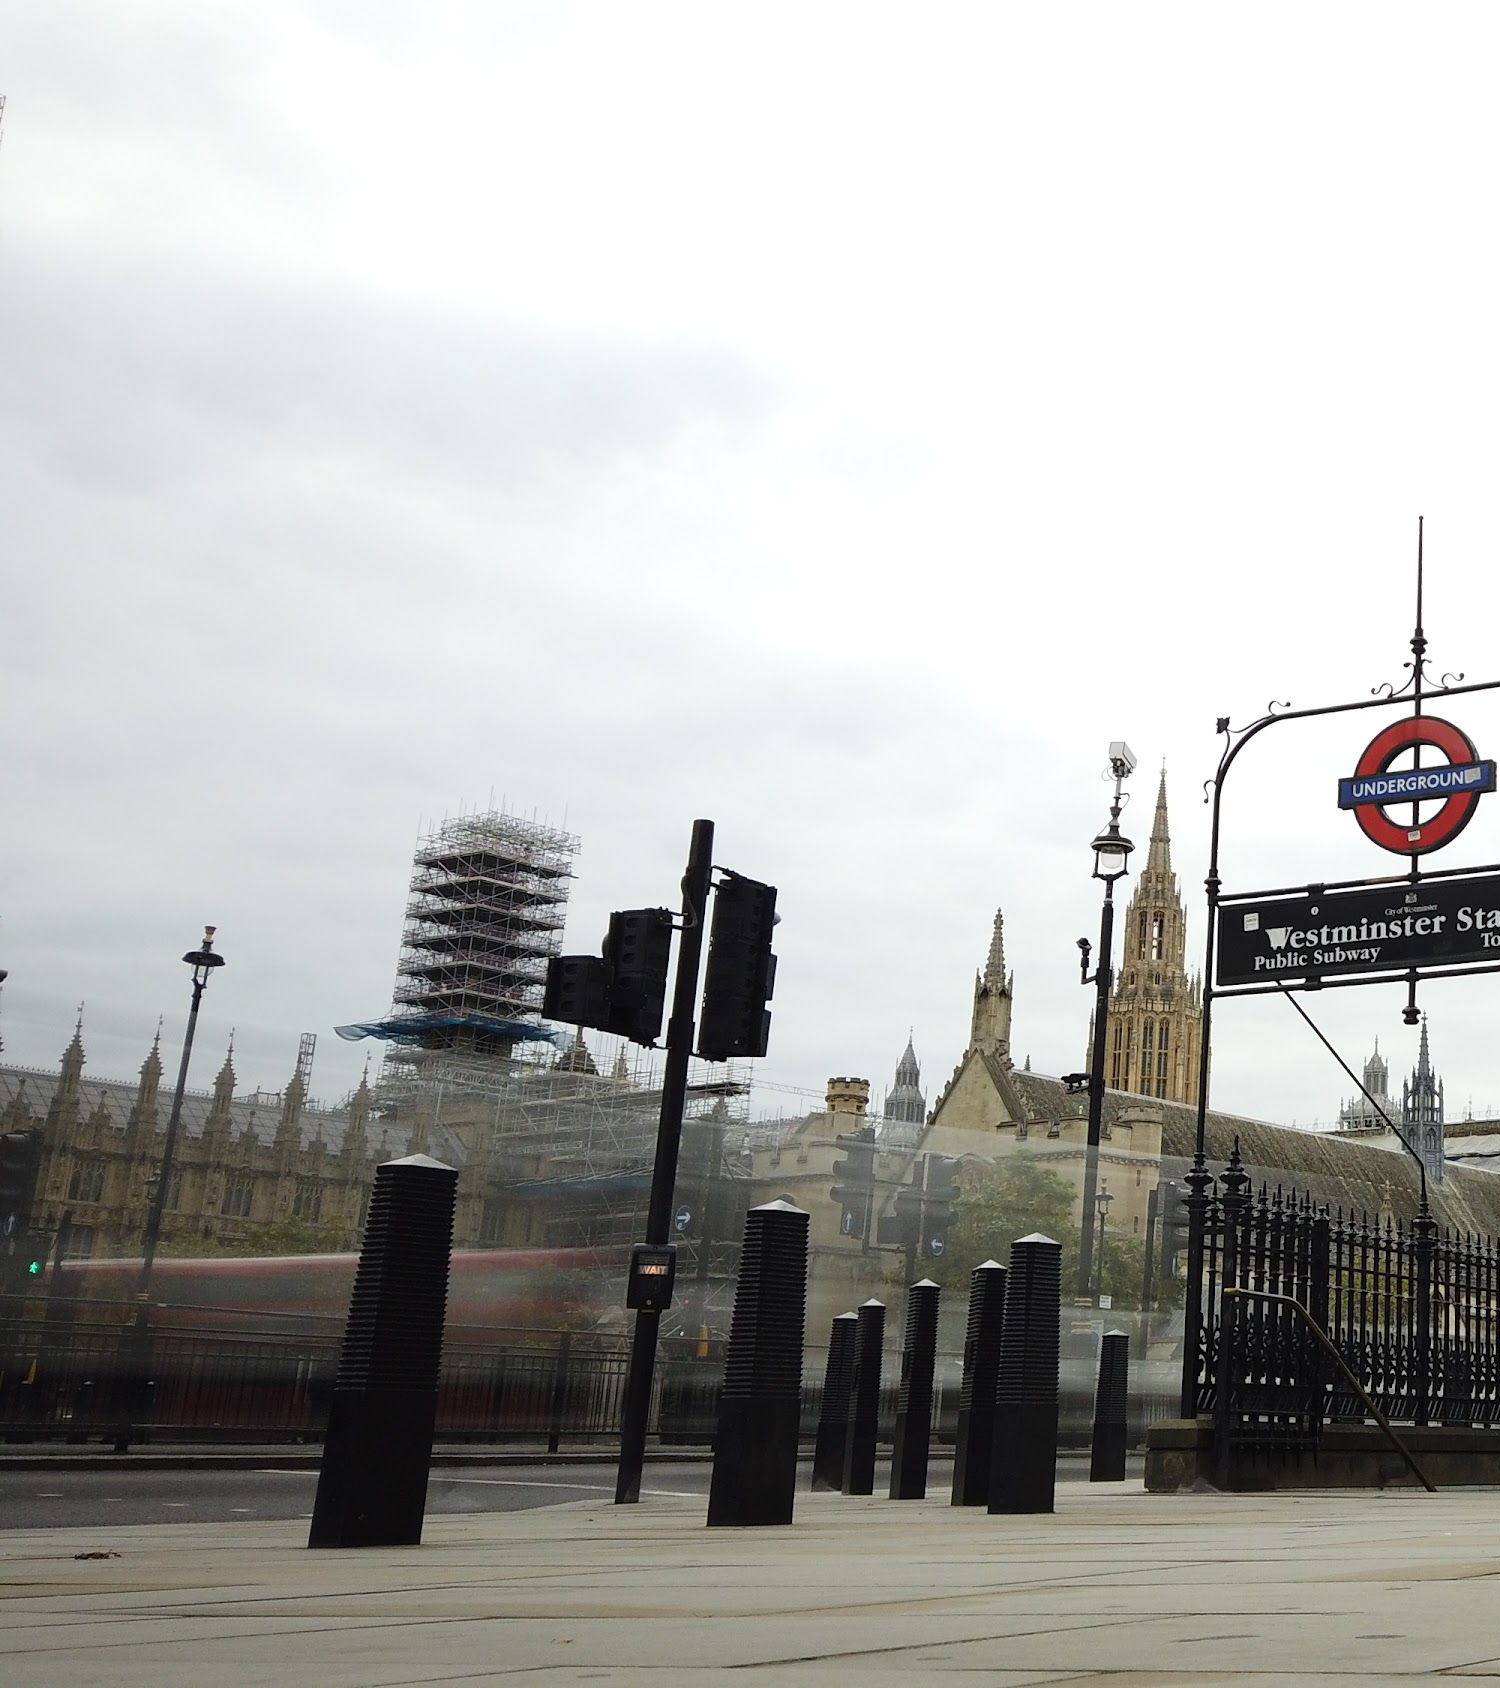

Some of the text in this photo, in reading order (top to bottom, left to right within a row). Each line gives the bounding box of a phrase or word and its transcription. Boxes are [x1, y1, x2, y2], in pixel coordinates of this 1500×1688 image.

[1384, 904, 1438, 917] City of Westminster
[1265, 914, 1447, 951] Westminster
[1253, 946, 1381, 971] Public Subway
[639, 1265, 668, 1275] WAIT
